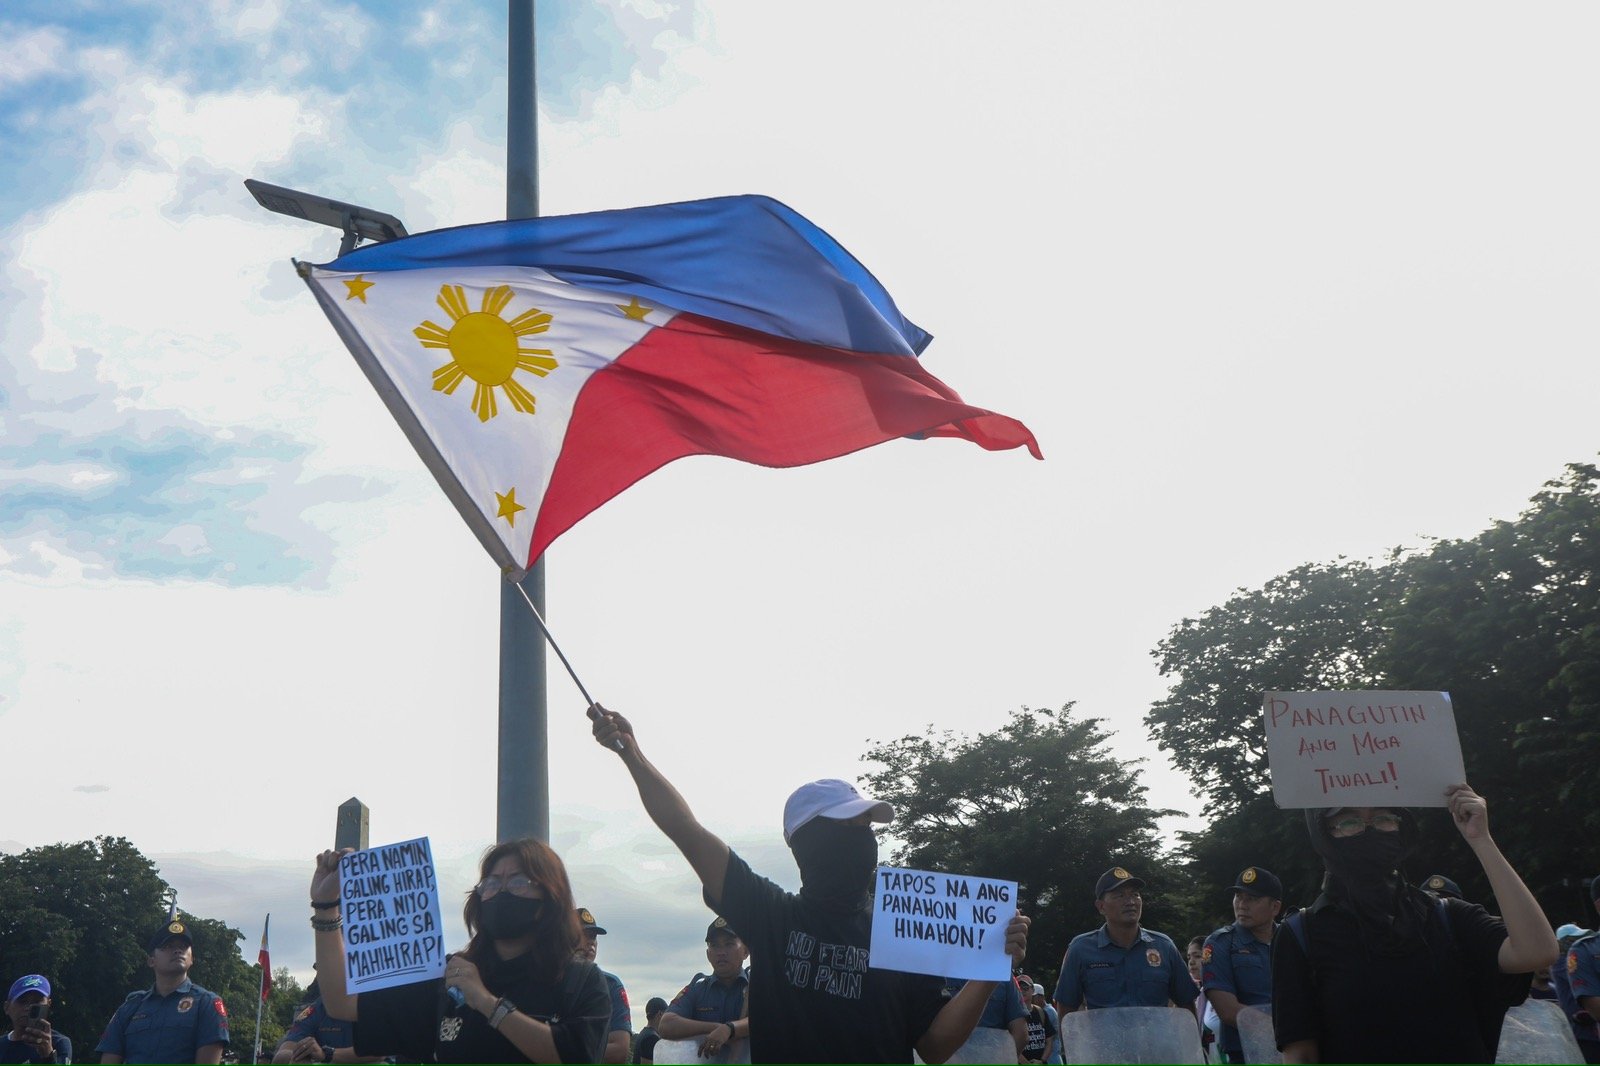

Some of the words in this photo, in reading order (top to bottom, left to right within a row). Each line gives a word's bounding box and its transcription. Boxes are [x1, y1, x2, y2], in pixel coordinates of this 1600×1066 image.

[1268, 697, 1426, 728] PANAGUTIN
[1299, 736, 1337, 760] ANG
[1314, 761, 1399, 794] TIWALI!
[341, 851, 380, 878] PERA
[381, 841, 429, 871] NAMIN
[343, 873, 391, 900] GALING
[392, 865, 436, 893] HIRAP,
[881, 872, 936, 895] TAPOS
[946, 878, 970, 899] NA
[976, 882, 1010, 903] ANG
[345, 899, 387, 924] PERA
[393, 891, 429, 916] NIYO
[882, 894, 957, 921] PANAHON
[972, 905, 997, 925] NG
[347, 916, 409, 945] GALING
[412, 911, 435, 935] SA
[894, 917, 986, 950] HINAHON!
[346, 935, 443, 979] MAHIHIRAP!
[785, 930, 816, 959] NO
[818, 942, 870, 974] FEAR
[784, 958, 812, 988] NO
[814, 965, 862, 1000] PAIN
